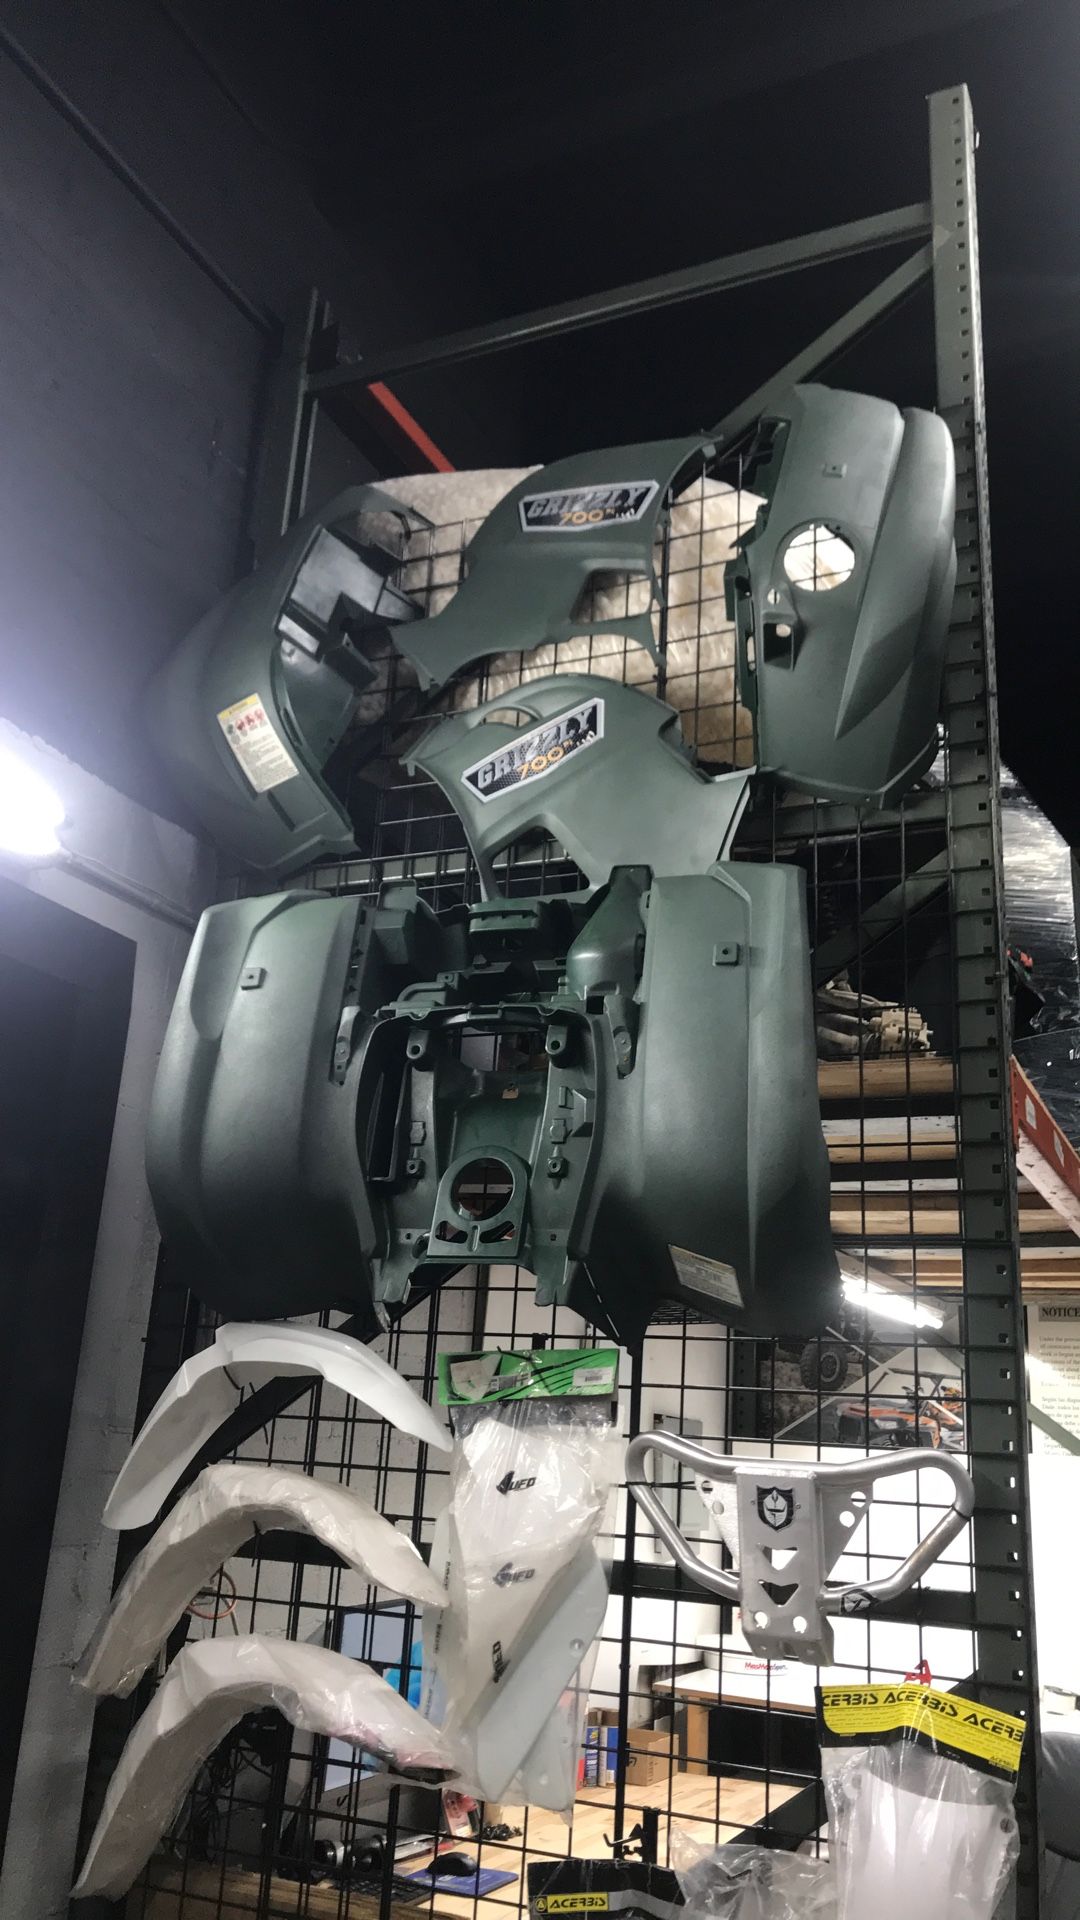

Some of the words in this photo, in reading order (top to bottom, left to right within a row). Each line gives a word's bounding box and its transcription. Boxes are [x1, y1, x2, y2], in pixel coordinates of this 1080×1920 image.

[527, 487, 647, 518] GRIZZLY
[560, 508, 605, 526] 700
[477, 708, 593, 789] GRIZZLY
[516, 745, 565, 780] 700
[509, 1476, 537, 1491] UFO
